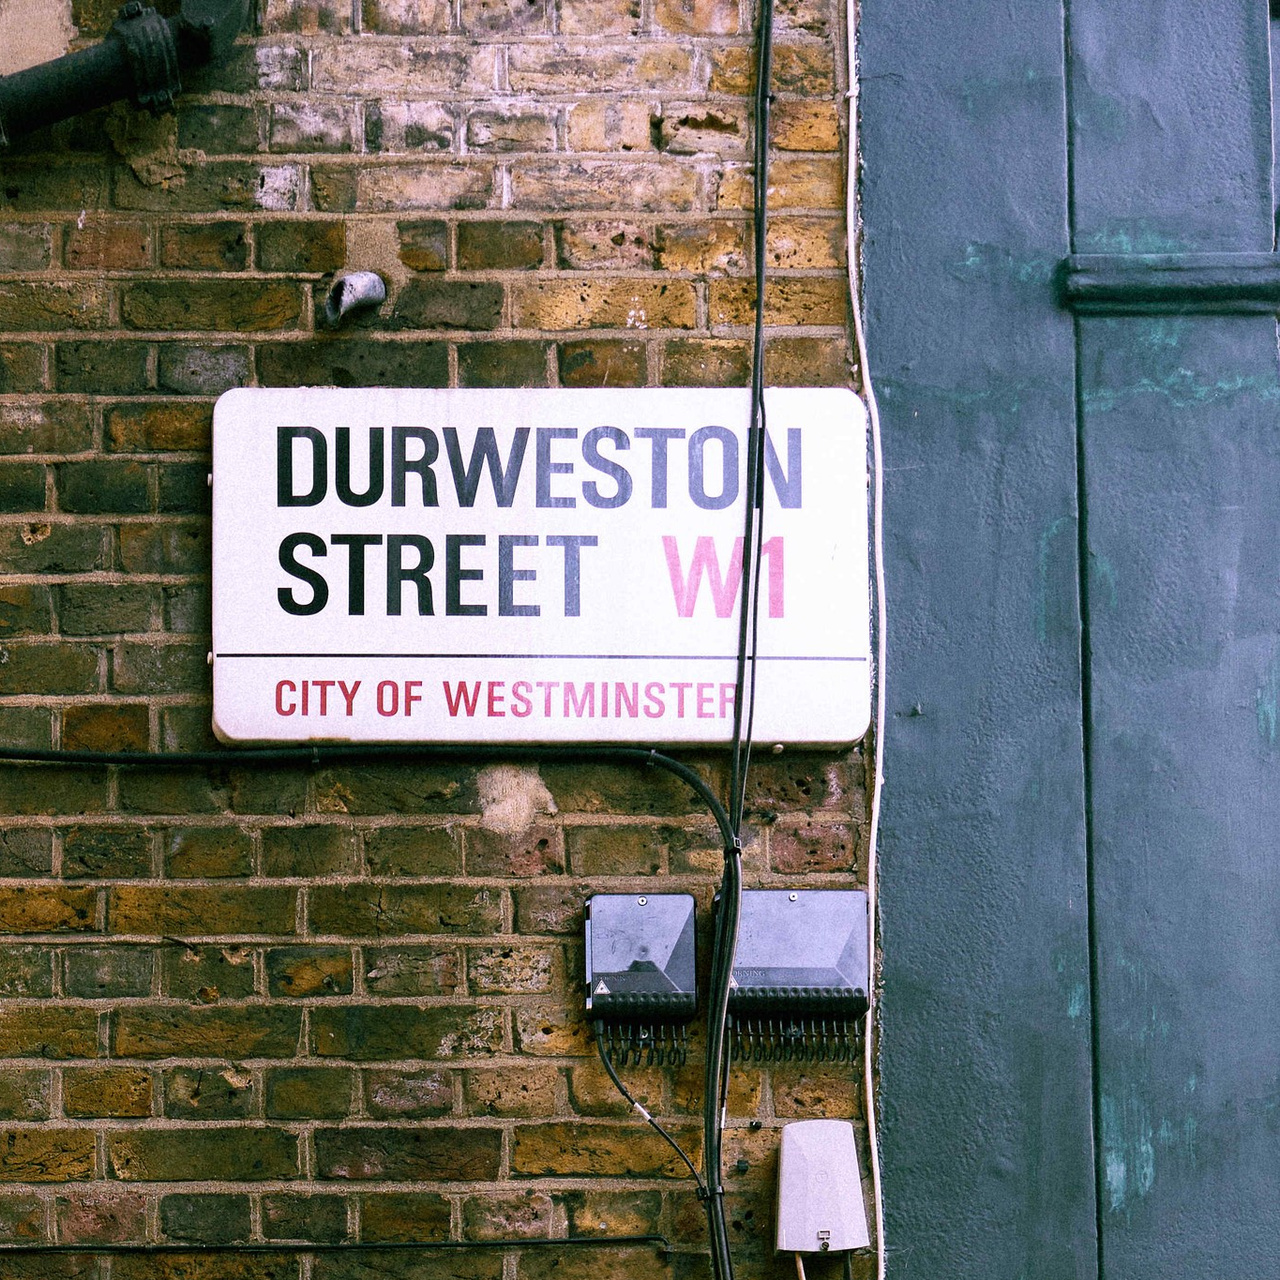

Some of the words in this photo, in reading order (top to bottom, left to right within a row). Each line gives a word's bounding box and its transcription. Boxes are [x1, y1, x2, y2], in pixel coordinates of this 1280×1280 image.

[276, 426, 802, 510] DURWESTON
[277, 532, 598, 617] STREET
[662, 534, 784, 619] W1
[275, 680, 362, 717] CITY
[377, 680, 423, 717] OF
[443, 681, 737, 719] WESTMINSTER
